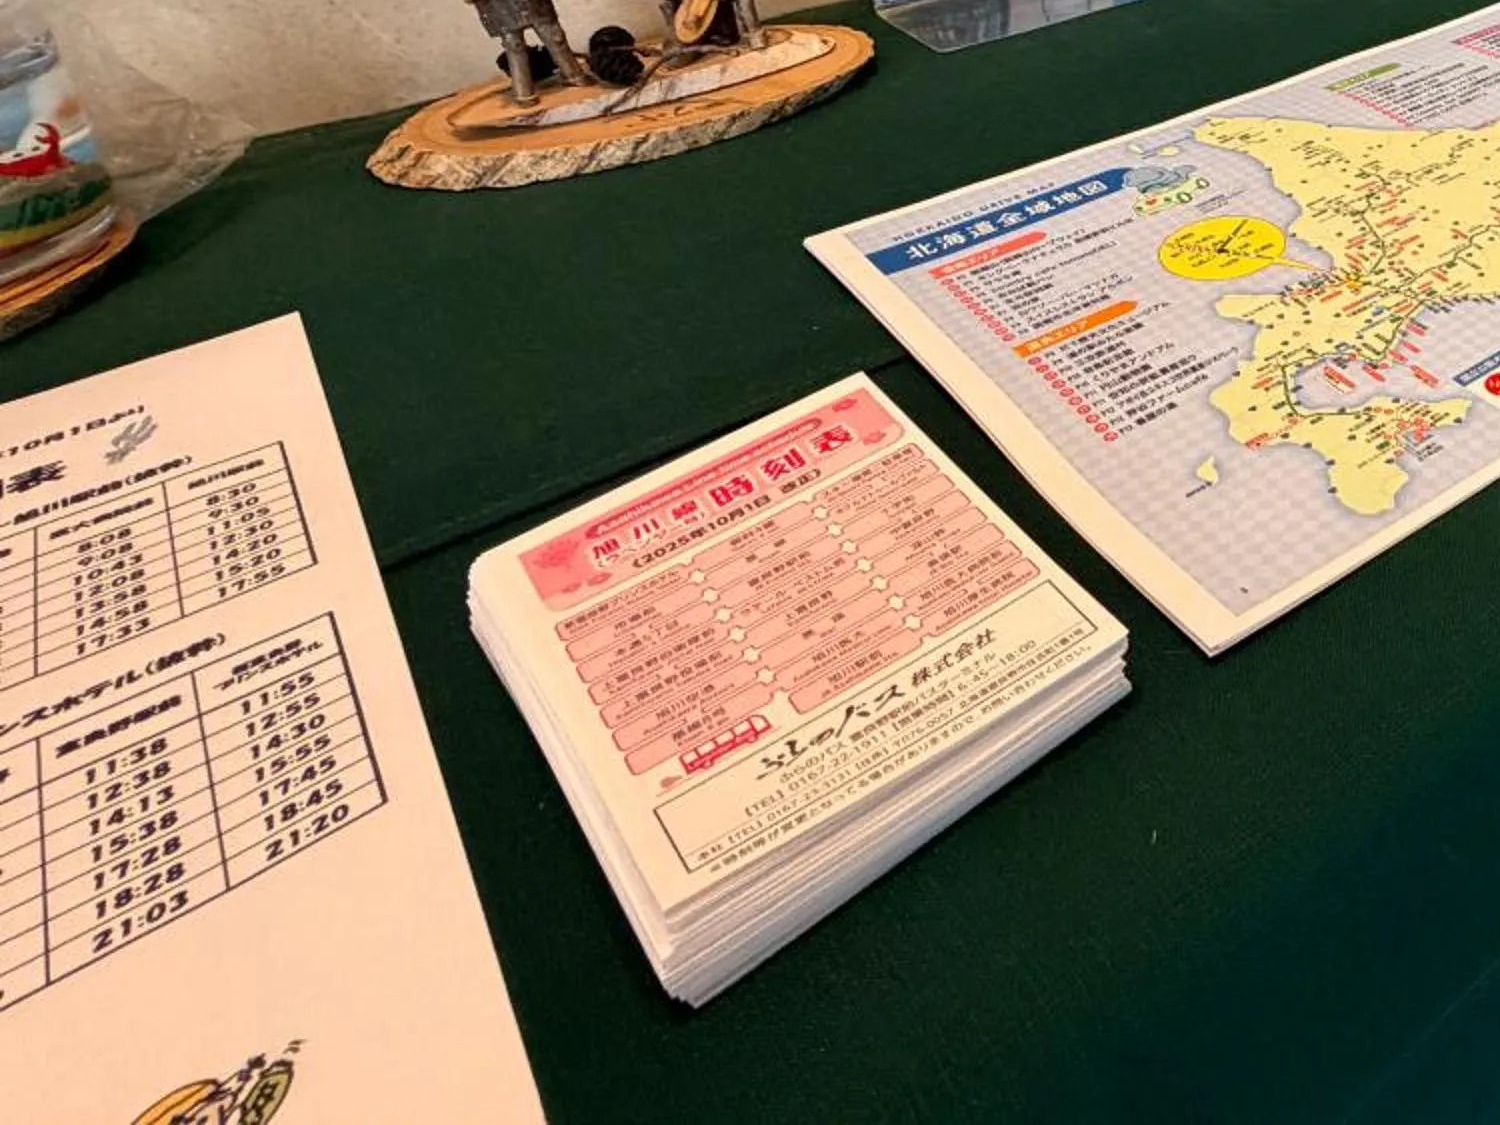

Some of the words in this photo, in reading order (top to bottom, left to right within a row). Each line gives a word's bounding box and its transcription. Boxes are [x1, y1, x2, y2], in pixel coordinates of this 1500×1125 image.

[893, 210, 973, 242] HOKKAIDO
[905, 181, 1108, 259] 北海道全域地図
[205, 483, 257, 507] 8:30
[208, 496, 260, 519] 9:30
[207, 507, 271, 536] 11:05
[209, 520, 274, 551] 12:30
[73, 553, 143, 586] 10:43
[211, 534, 277, 565] 14:20
[215, 549, 281, 582] 15:20
[75, 585, 147, 619] 13:58
[218, 564, 285, 598] 17:55
[75, 600, 148, 636] 14:58
[76, 617, 151, 656] 17:33
[904, 626, 1001, 688] 株式会社
[241, 671, 316, 715] 11:55
[244, 692, 321, 737] 12:55
[55, 695, 182, 759] 富良野駅前
[250, 713, 326, 760] 14:30
[84, 737, 168, 786] 11:38
[254, 735, 331, 783] 15:55
[258, 756, 337, 807] 17:45
[86, 761, 171, 810] 12:38
[263, 779, 344, 832] 18:45
[89, 786, 175, 836] 14:13
[264, 803, 350, 861] 21:20
[91, 810, 179, 863] 15:38
[93, 835, 182, 891] 17:28
[95, 862, 186, 919] 18:28
[92, 890, 189, 953] 21:03
